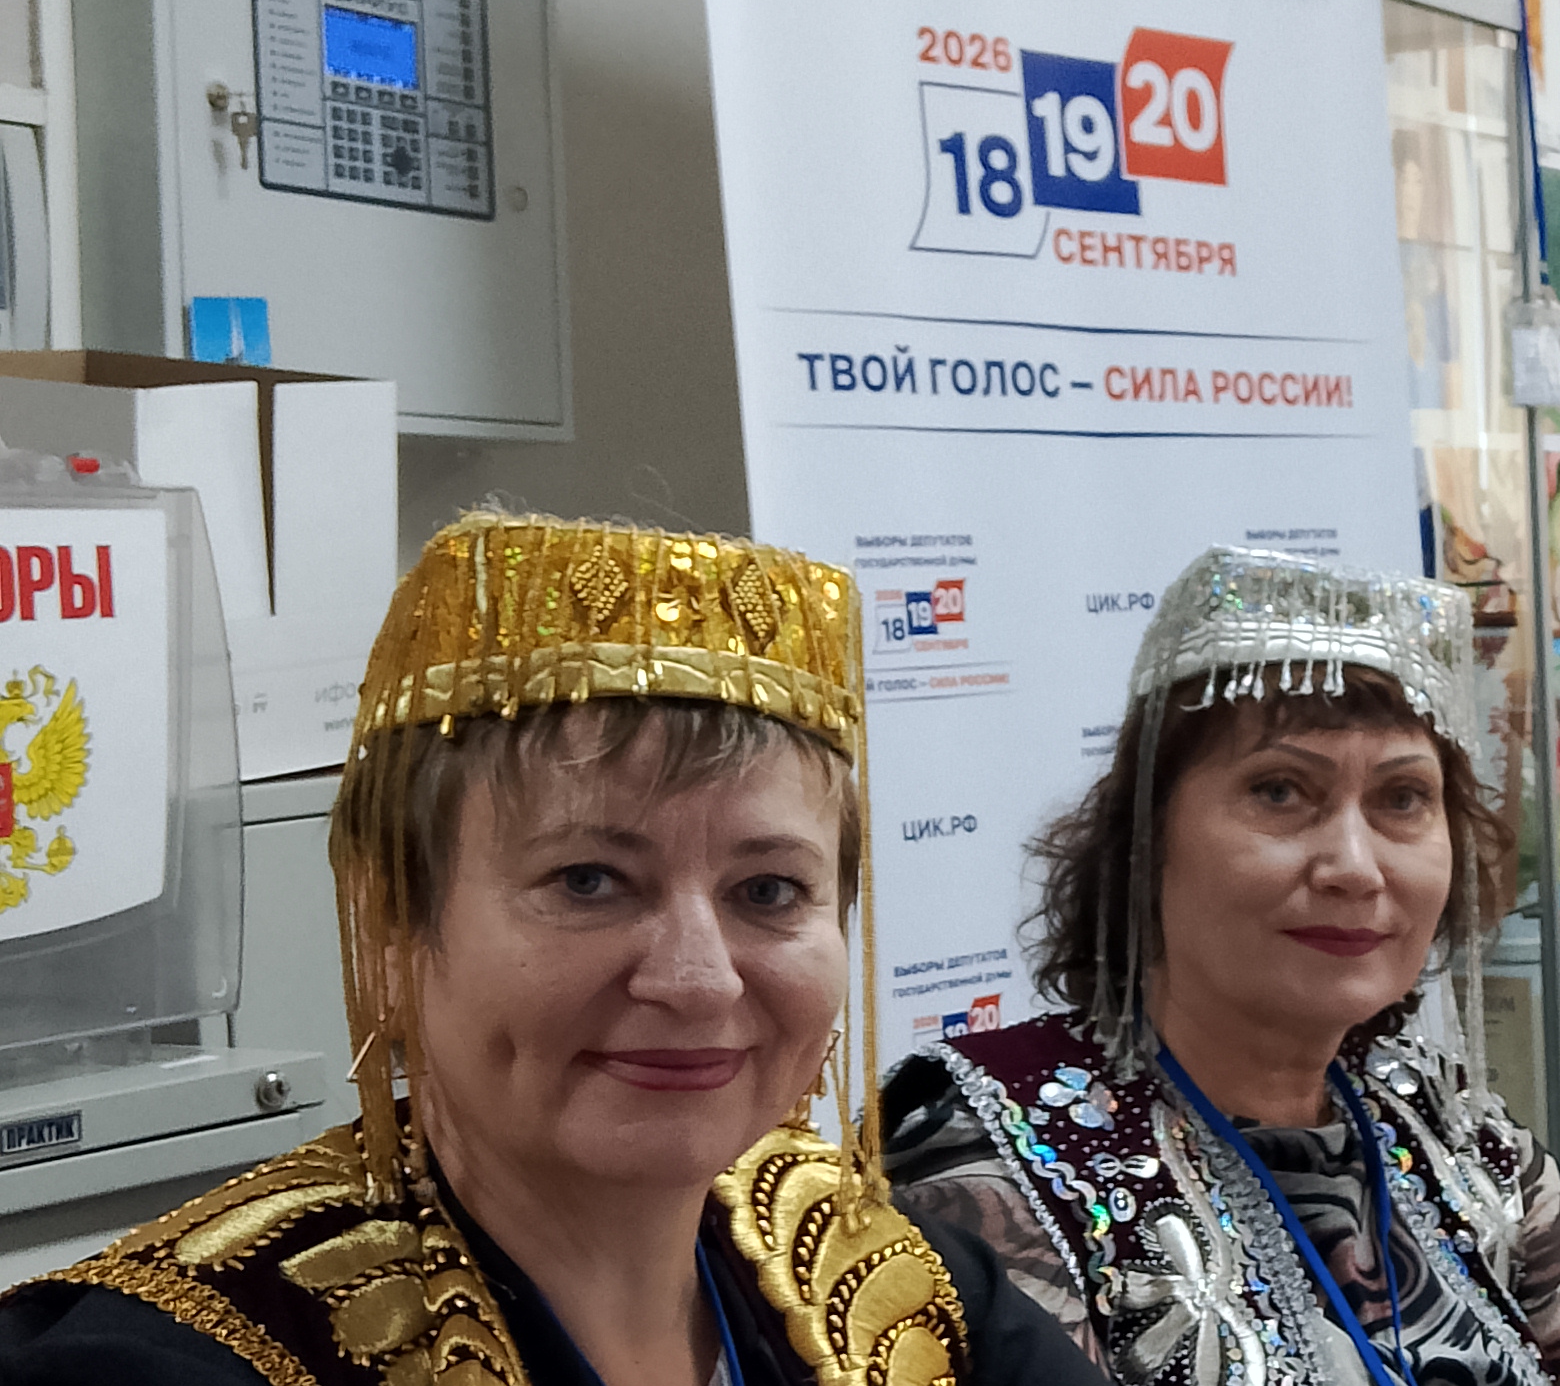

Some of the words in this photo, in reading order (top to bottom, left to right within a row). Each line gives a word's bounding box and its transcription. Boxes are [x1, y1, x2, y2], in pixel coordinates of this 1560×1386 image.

[917, 26, 1012, 73] 2026
[938, 131, 1023, 218] 18
[1032, 91, 1115, 181] 19
[1126, 61, 1219, 152] 20
[1053, 228, 1237, 277] СЕНТЯБРЯ
[797, 344, 917, 394] ТВОЙ
[929, 358, 1061, 397] ГОЛОС
[1104, 365, 1203, 403] СИЛА
[1211, 369, 1354, 408] РОССИИ!
[882, 617, 906, 642] 18
[908, 601, 933, 627] 19
[934, 588, 963, 615] 20
[1086, 591, 1155, 614] ЦИК.РФ
[903, 814, 978, 842] ЦИК.РФ
[6, 1115, 78, 1151] ПРАКТИК
